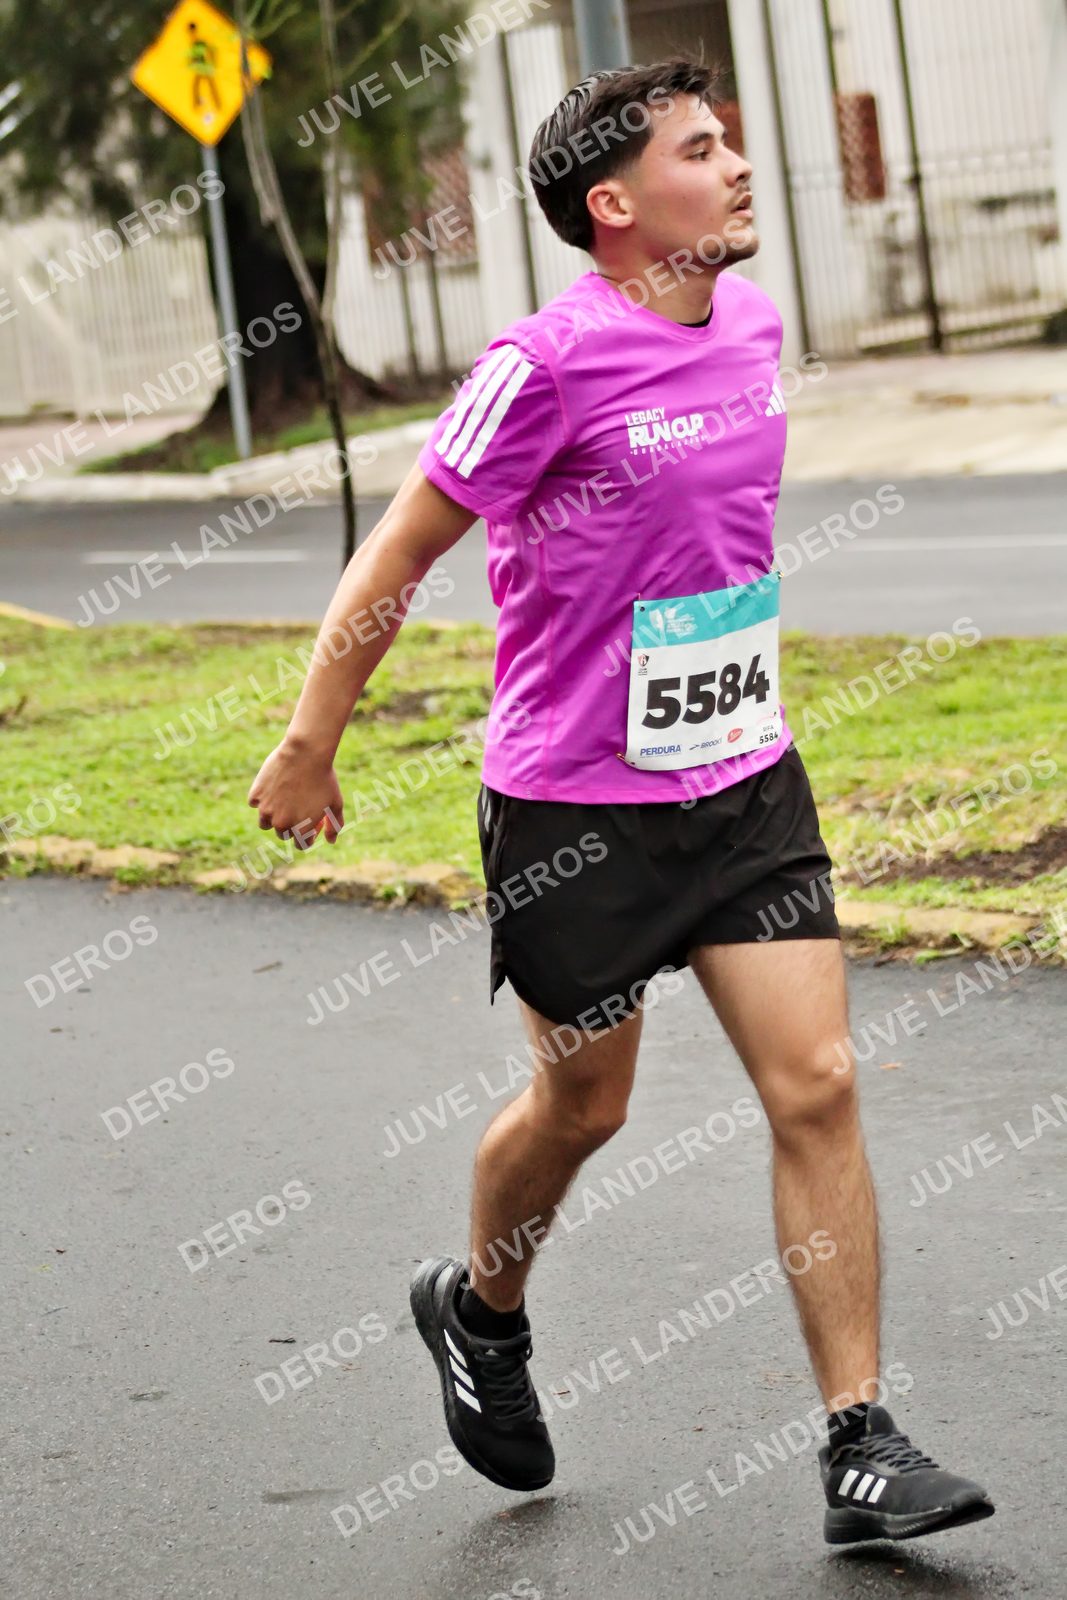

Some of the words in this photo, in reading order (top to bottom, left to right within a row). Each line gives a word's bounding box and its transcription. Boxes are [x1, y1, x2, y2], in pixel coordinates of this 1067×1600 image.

[625, 407, 665, 426] LEGACY
[628, 420, 672, 448] RUN
[641, 653, 770, 729] 5584
[759, 731, 779, 744] 5584
[640, 744, 681, 756] PERDURA
